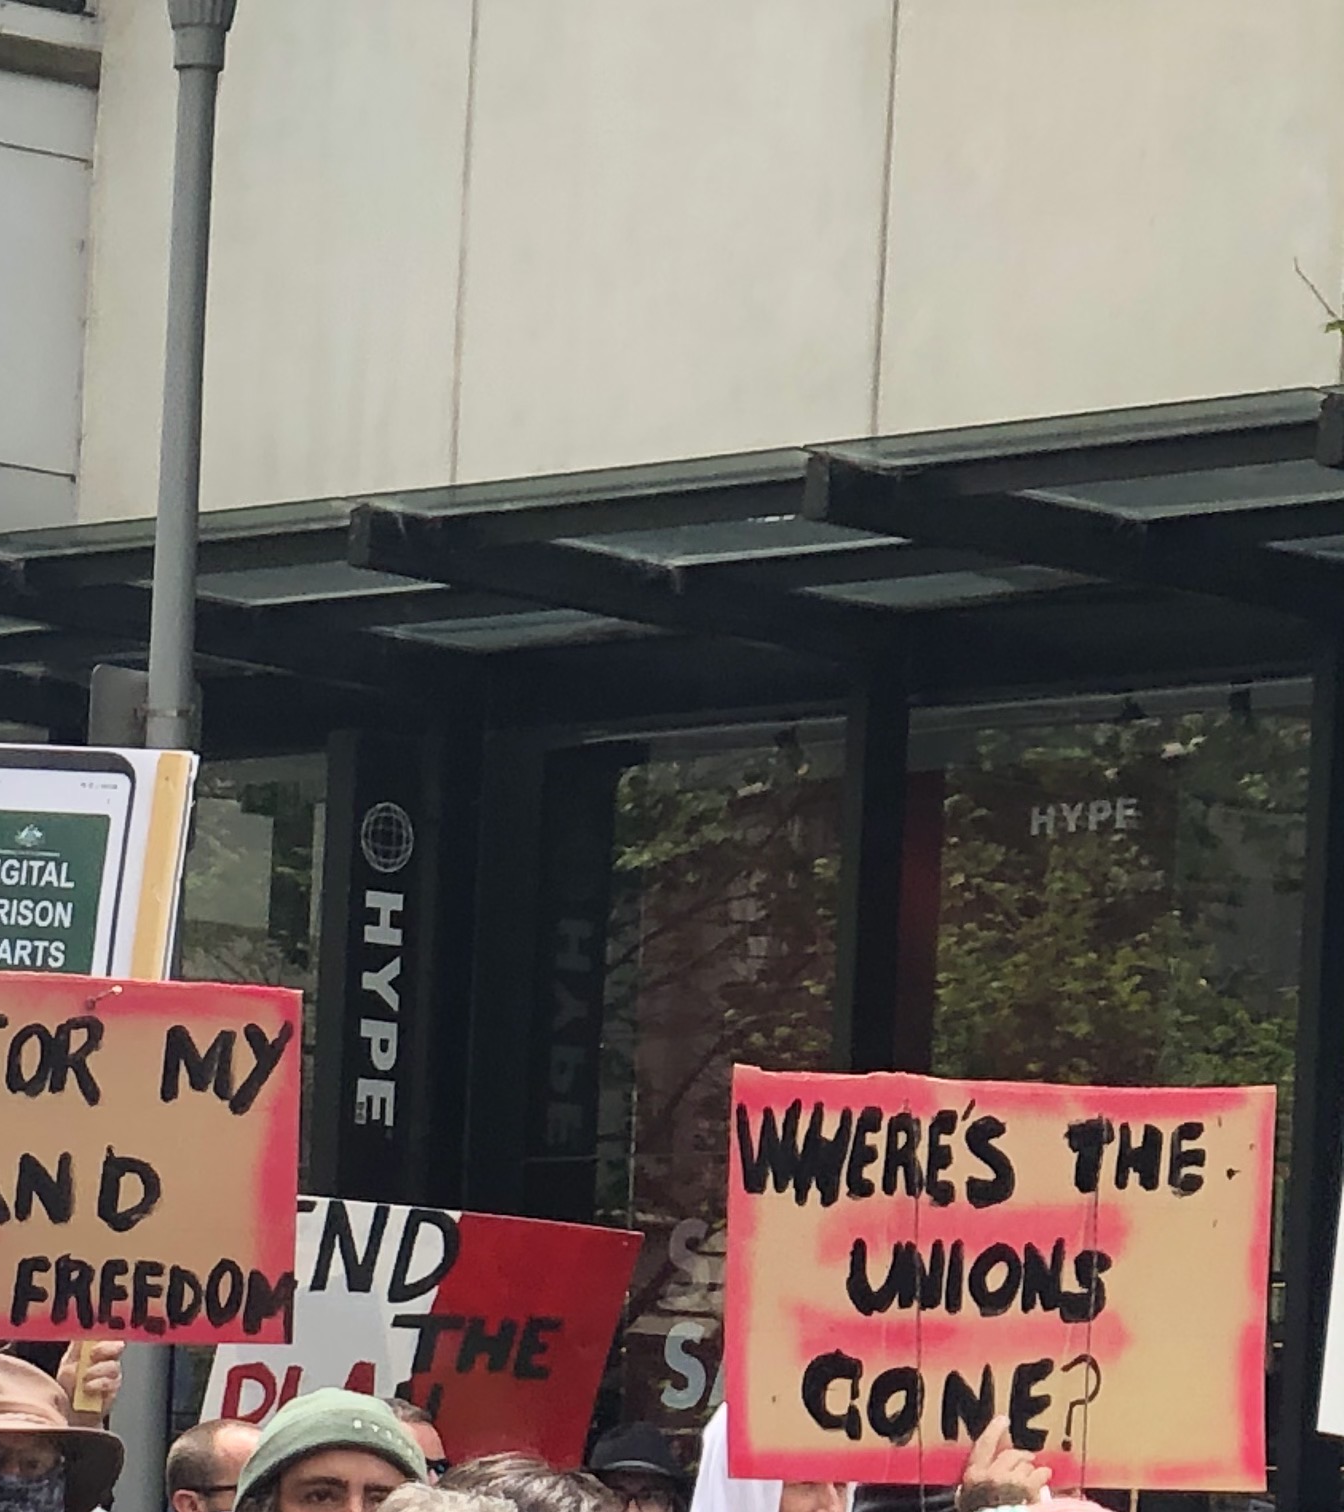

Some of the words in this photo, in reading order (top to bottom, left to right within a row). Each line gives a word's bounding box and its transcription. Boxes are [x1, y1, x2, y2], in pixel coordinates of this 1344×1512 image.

[1030, 797, 1141, 836] HYPE
[354, 888, 405, 1128] HYPE
[160, 1020, 294, 1116] MY
[736, 1099, 1016, 1208] WHERE'S
[1065, 1117, 1206, 1198] THE
[10, 1253, 297, 1344] FREEDOM
[296, 1198, 460, 1303] ND
[846, 1238, 1112, 1323] UNIONS
[391, 1313, 563, 1380] THE
[802, 1349, 1101, 1452] GONE?
